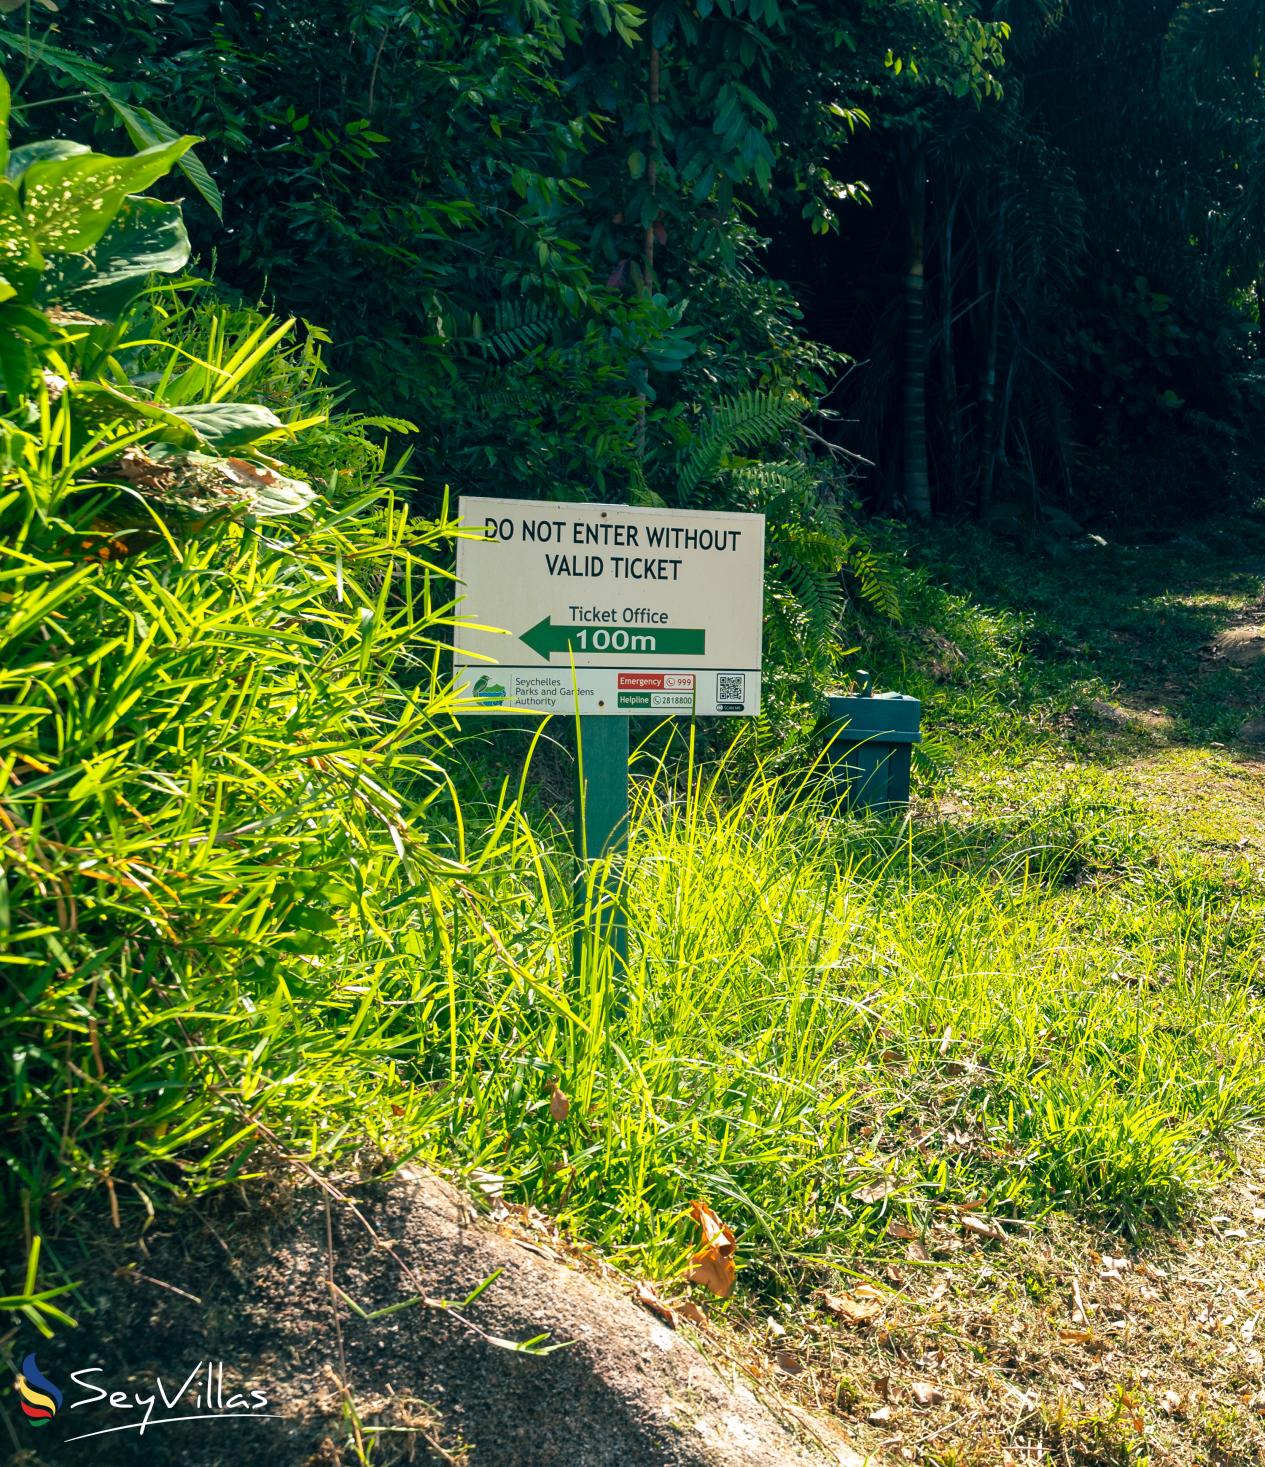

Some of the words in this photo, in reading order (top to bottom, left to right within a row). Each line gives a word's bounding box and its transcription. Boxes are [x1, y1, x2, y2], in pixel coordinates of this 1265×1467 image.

[484, 517, 514, 541] DO
[522, 520, 566, 543] NOT
[573, 523, 639, 547] ENTER
[646, 526, 741, 551] WITHOUT
[545, 554, 603, 577] VALID
[611, 557, 682, 581] TICKET
[569, 606, 617, 623] Ticket
[623, 608, 668, 624] Office
[576, 629, 656, 651] 100m
[515, 677, 561, 688] Seychelles
[620, 677, 661, 687] Emergency
[677, 678, 692, 686] 999
[515, 687, 537, 696] Parks
[541, 688, 557, 696] and
[515, 697, 556, 707] Authority
[620, 696, 649, 705] Helpline
[662, 696, 692, 705] 2818800
